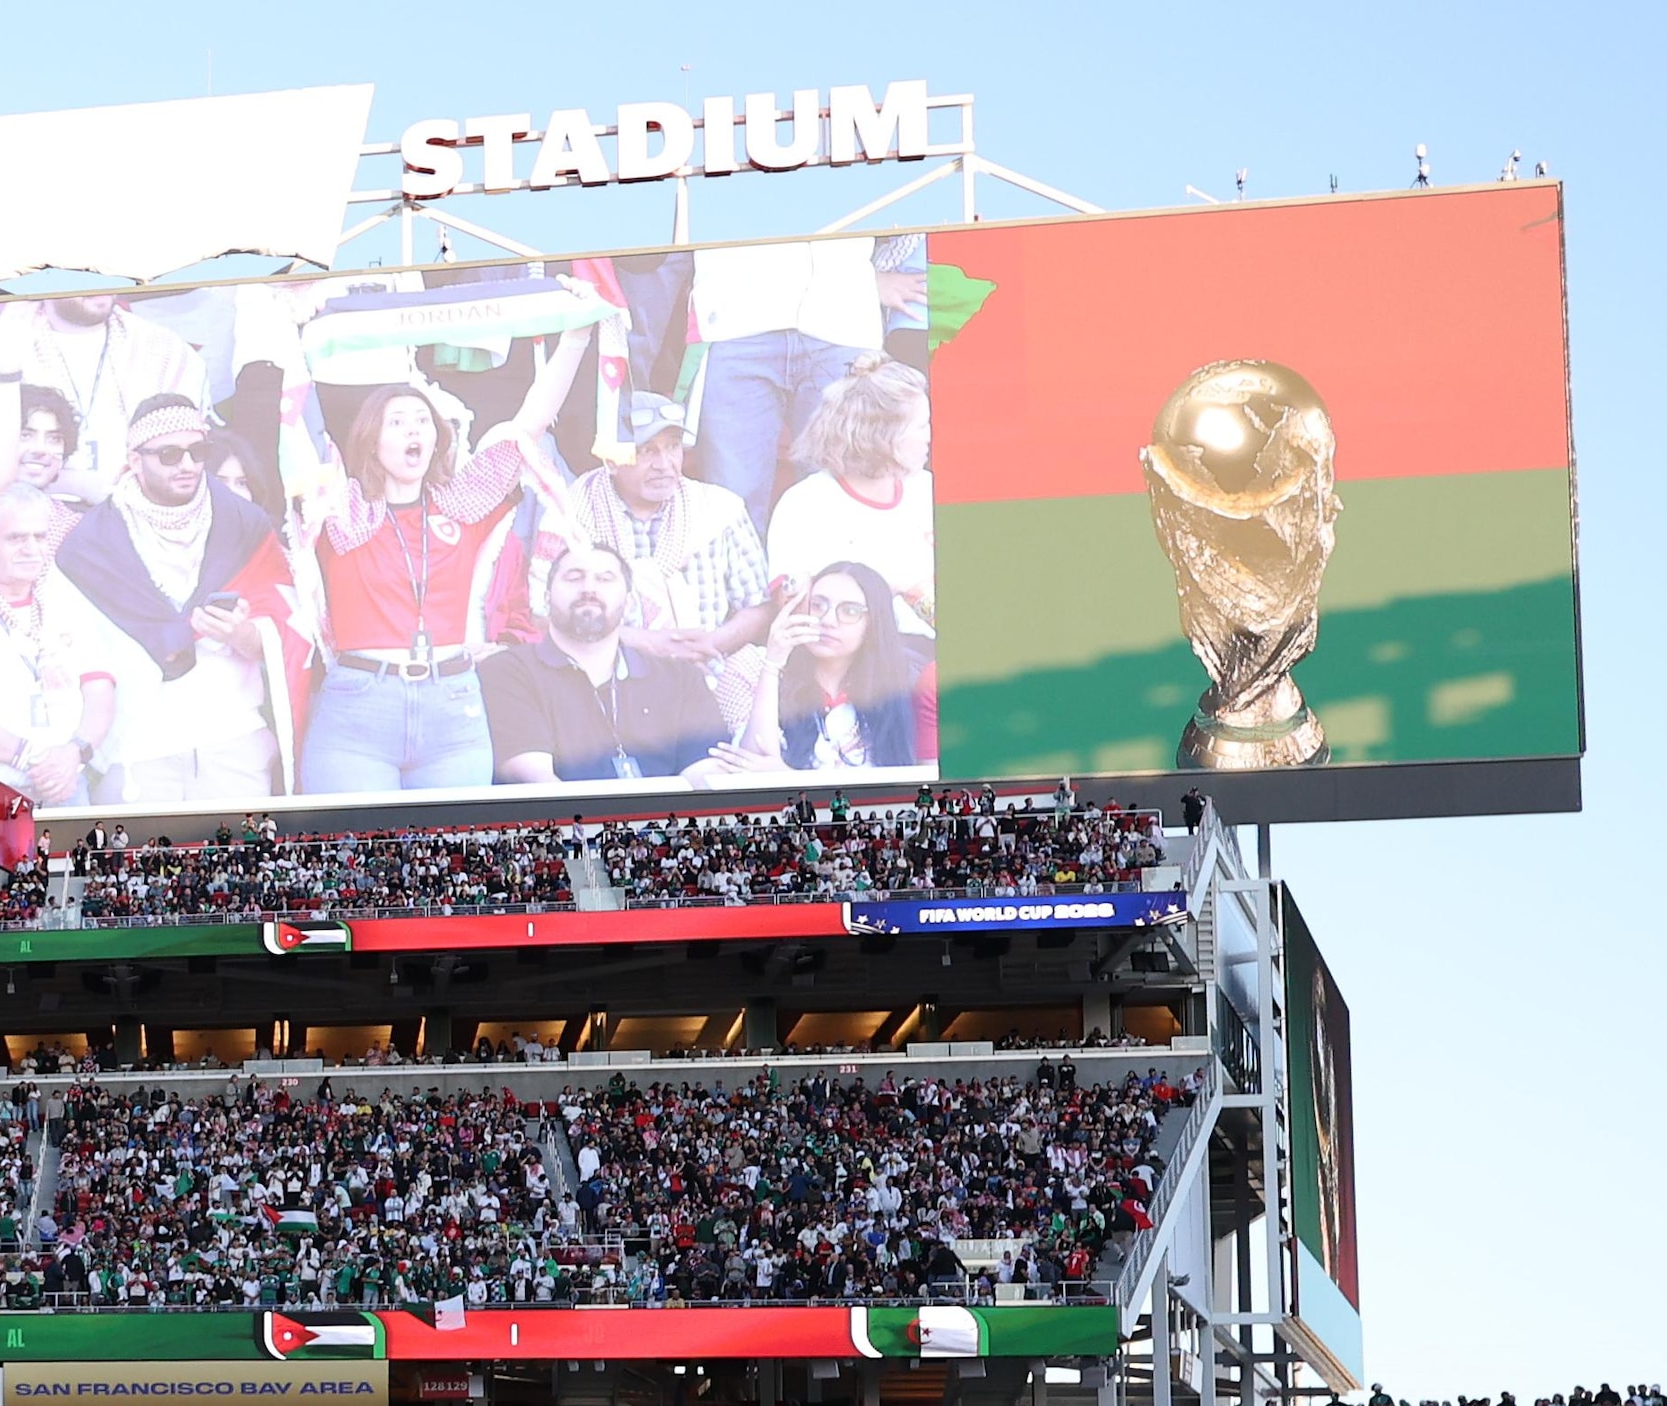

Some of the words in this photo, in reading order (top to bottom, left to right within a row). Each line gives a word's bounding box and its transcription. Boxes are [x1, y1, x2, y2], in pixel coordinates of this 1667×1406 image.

[400, 79, 928, 200] STADIUM
[399, 303, 501, 326] JORDAN
[919, 909, 956, 924] FIFA
[956, 907, 1017, 922] WORLD
[1018, 905, 1053, 920] CUP
[840, 1066, 857, 1074] 231
[282, 1079, 298, 1087] 230
[8, 1328, 25, 1348] AL
[15, 1382, 69, 1397] SAN
[76, 1381, 235, 1397] FRANCISCO
[240, 1381, 293, 1396] BAY
[299, 1381, 374, 1396] AREA
[424, 1380, 445, 1391] 128
[447, 1380, 468, 1391] 129
